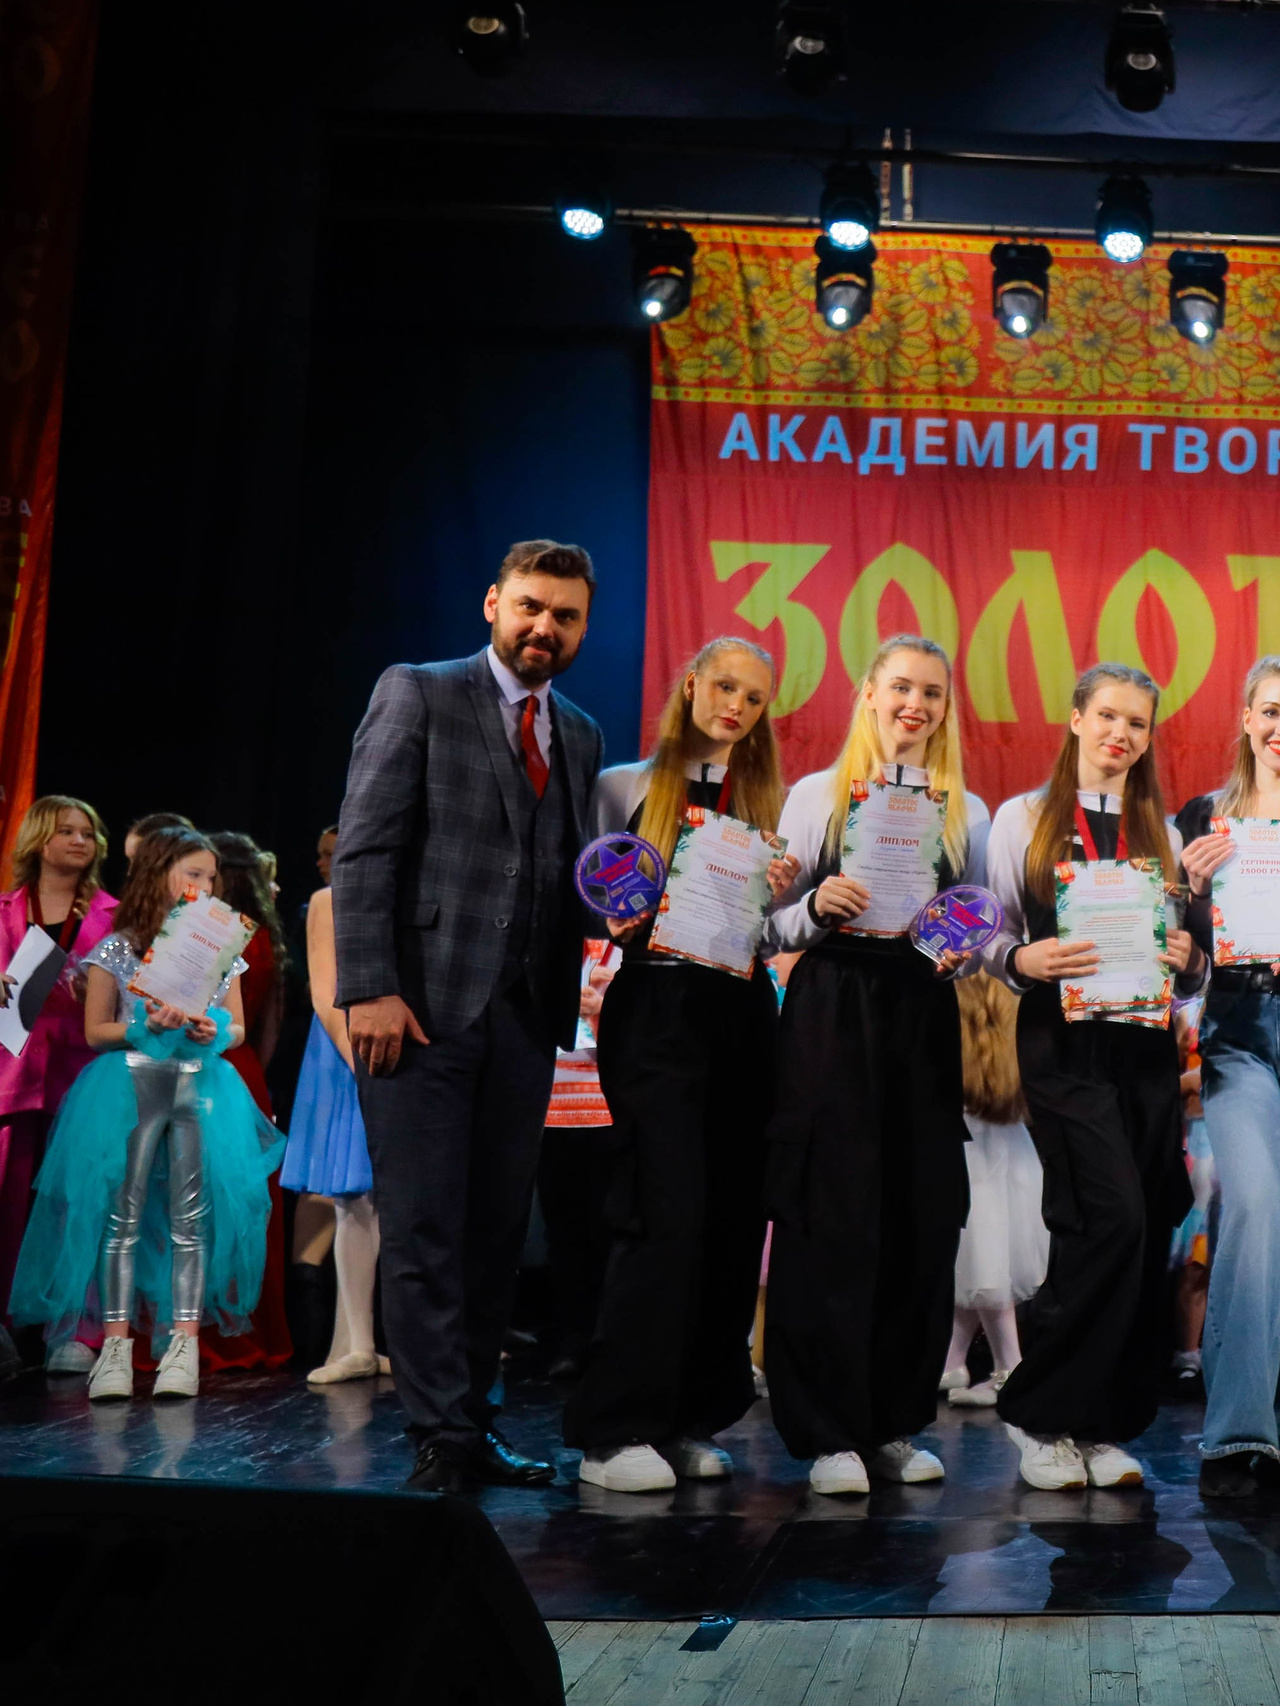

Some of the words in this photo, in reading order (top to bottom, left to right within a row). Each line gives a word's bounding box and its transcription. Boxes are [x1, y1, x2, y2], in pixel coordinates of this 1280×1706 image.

[718, 412, 1099, 476] АКАДЕМИЯ
[876, 835, 920, 848] ДИПЛОМ
[704, 862, 749, 884] ДИПЛОМ
